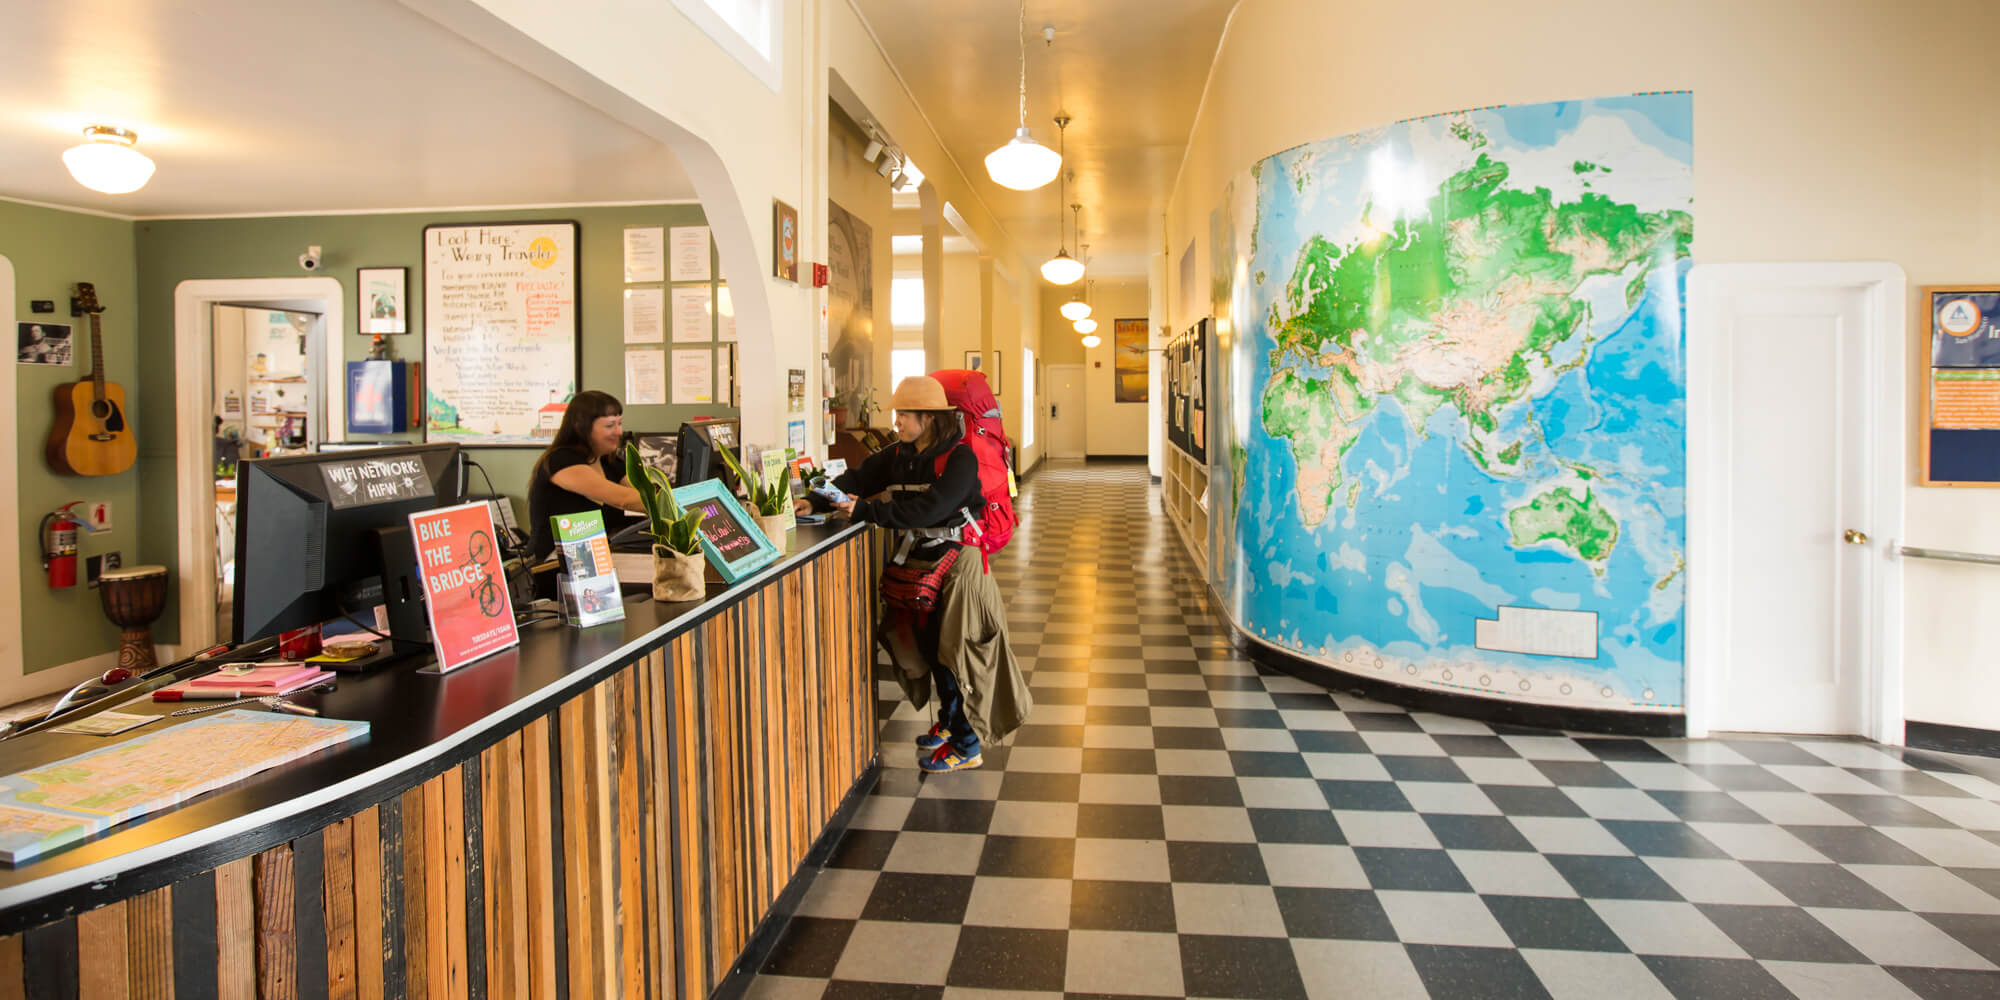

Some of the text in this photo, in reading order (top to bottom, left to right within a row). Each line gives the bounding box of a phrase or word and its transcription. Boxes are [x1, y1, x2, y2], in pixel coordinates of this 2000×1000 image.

[438, 229, 469, 246] Look
[328, 461, 420, 483] WIFI NETWORK:
[367, 481, 398, 498] HIFW
[419, 519, 452, 541] BIKE
[425, 545, 453, 568] THE
[429, 563, 484, 593] BRIDGE
